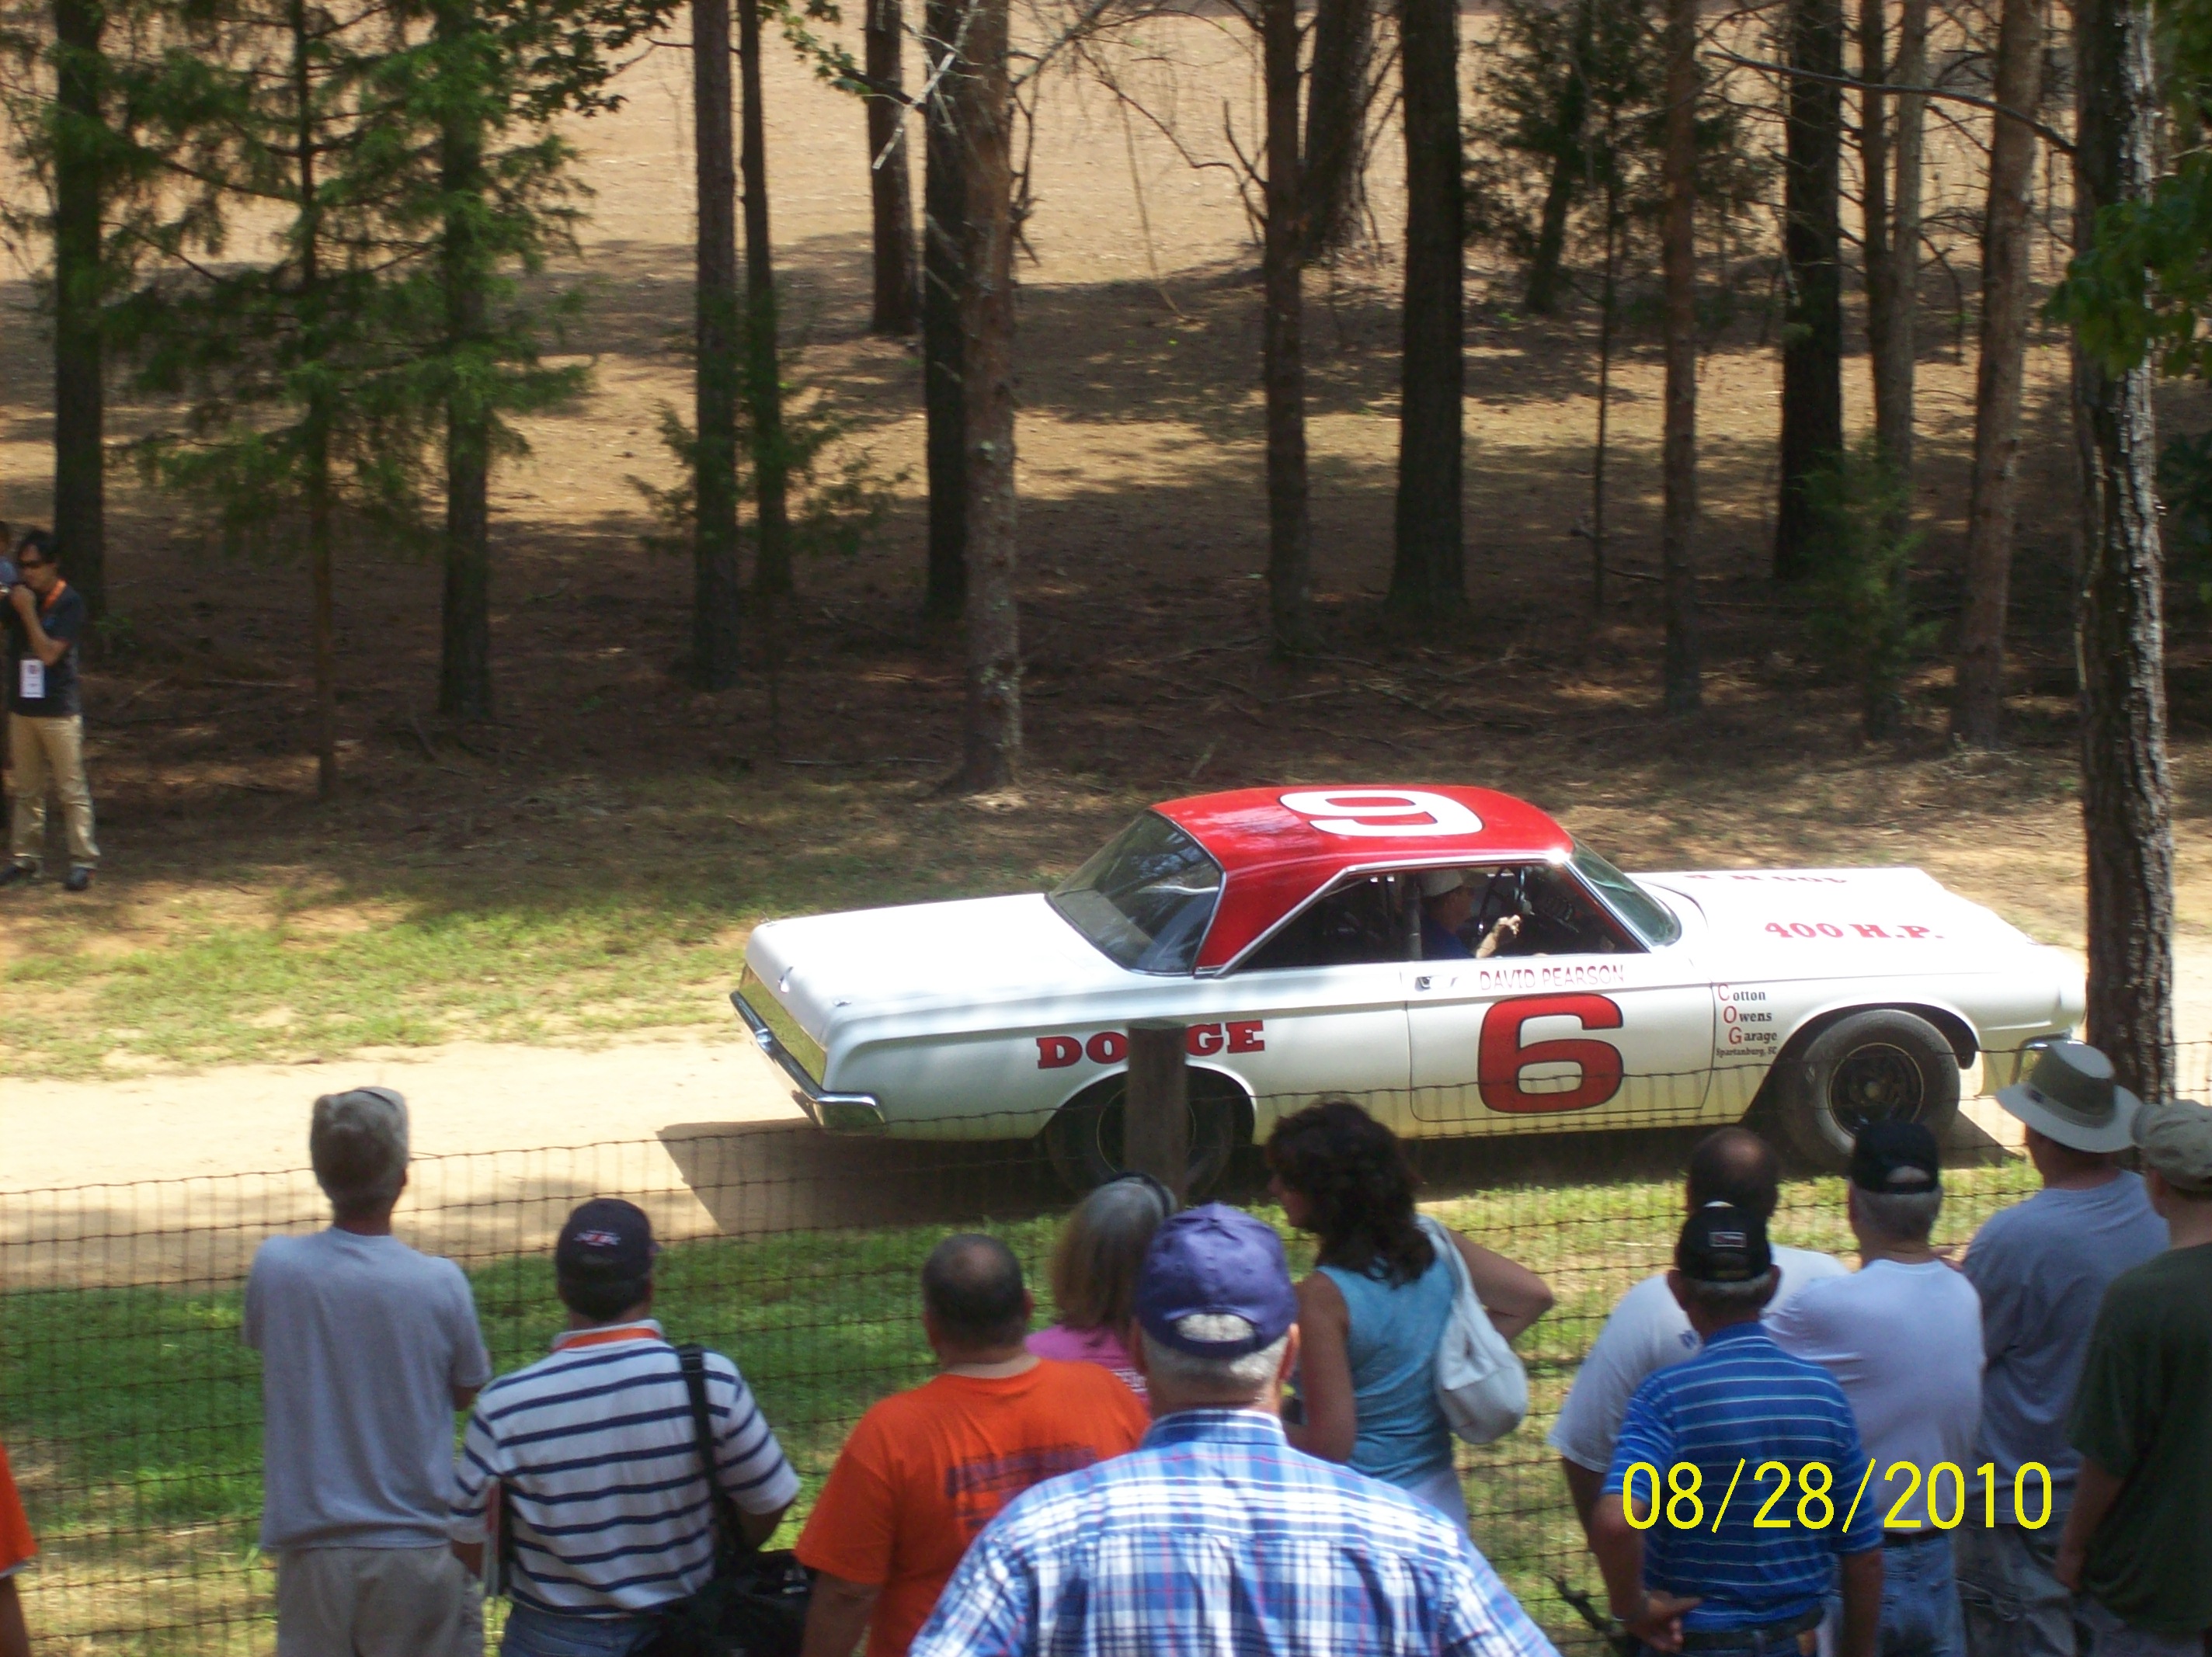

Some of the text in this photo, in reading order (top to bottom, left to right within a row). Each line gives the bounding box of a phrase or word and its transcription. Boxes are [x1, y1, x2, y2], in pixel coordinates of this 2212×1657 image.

[1765, 922, 1945, 939] 400 H.P.
[1480, 964, 1625, 991] DAVID PEARSON
[1718, 983, 1766, 1002] Cotton
[1723, 1006, 1772, 1024] Owens
[1035, 1020, 1265, 1069] DOGE
[1729, 1027, 1777, 1045] Garage
[1477, 992, 1624, 1113] 6
